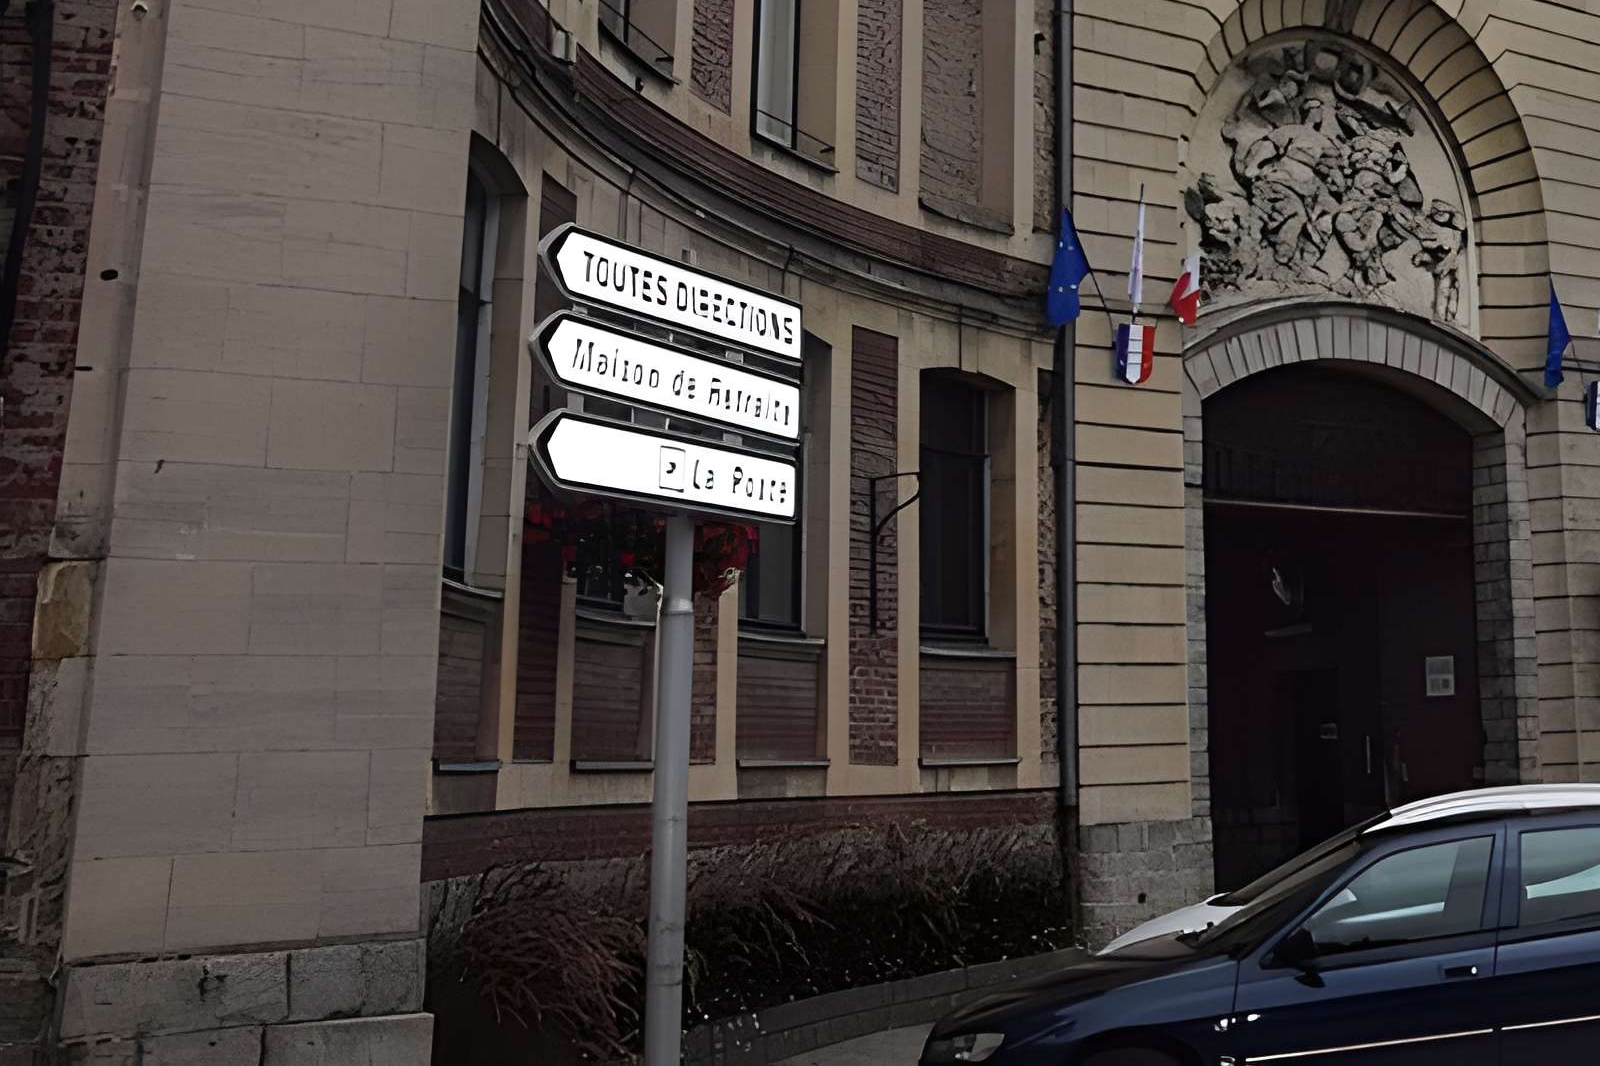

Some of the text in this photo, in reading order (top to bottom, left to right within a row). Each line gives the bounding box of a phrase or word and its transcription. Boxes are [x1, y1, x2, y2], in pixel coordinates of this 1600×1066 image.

[583, 250, 668, 306] TOUTES
[672, 370, 697, 400] de
[708, 377, 790, 427] Rtrait
[693, 458, 715, 490] La
